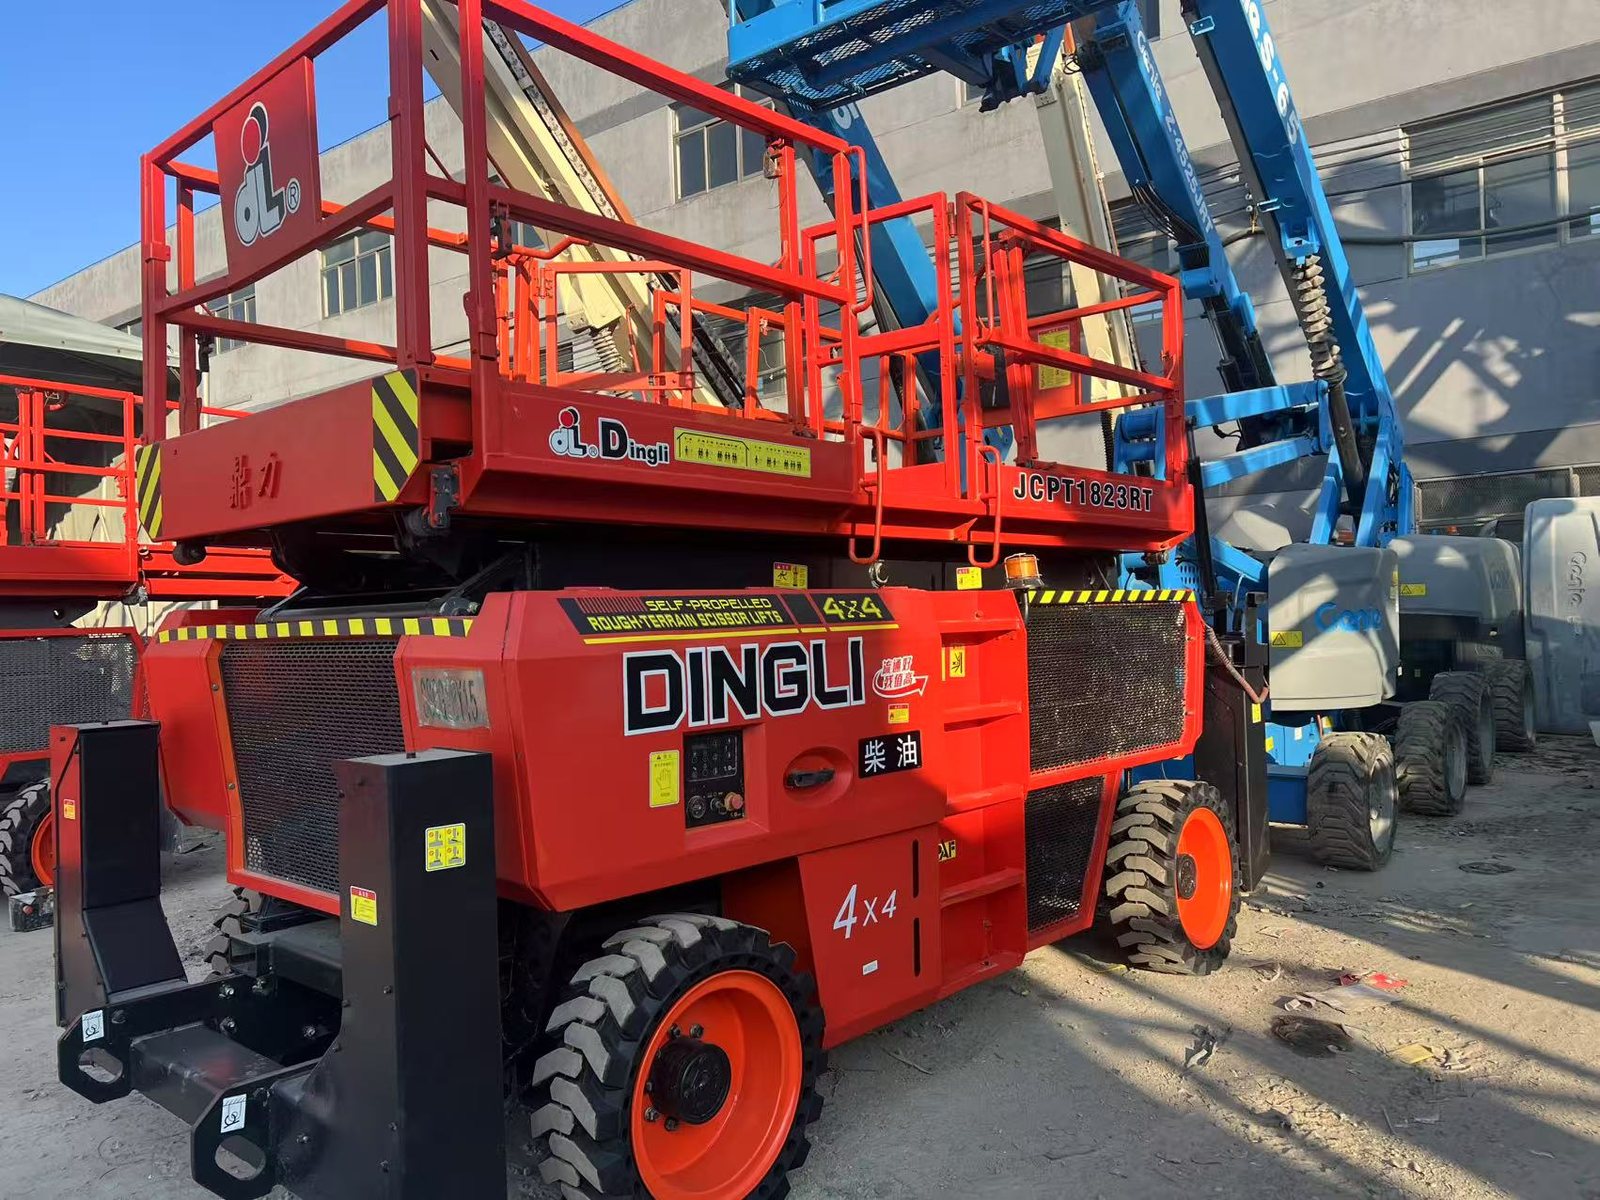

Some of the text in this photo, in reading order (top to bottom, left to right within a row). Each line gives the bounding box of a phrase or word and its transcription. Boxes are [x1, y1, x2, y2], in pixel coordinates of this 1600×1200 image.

[599, 417, 670, 467] Dingli
[1013, 472, 1153, 512] JCPT1823RT
[587, 610, 784, 631] ROUGH-TERRAIN SCISSOR LIFTS
[645, 597, 772, 612] SELF-PROPELLED
[622, 636, 866, 737] DINGLI
[864, 734, 919, 773] 柴油
